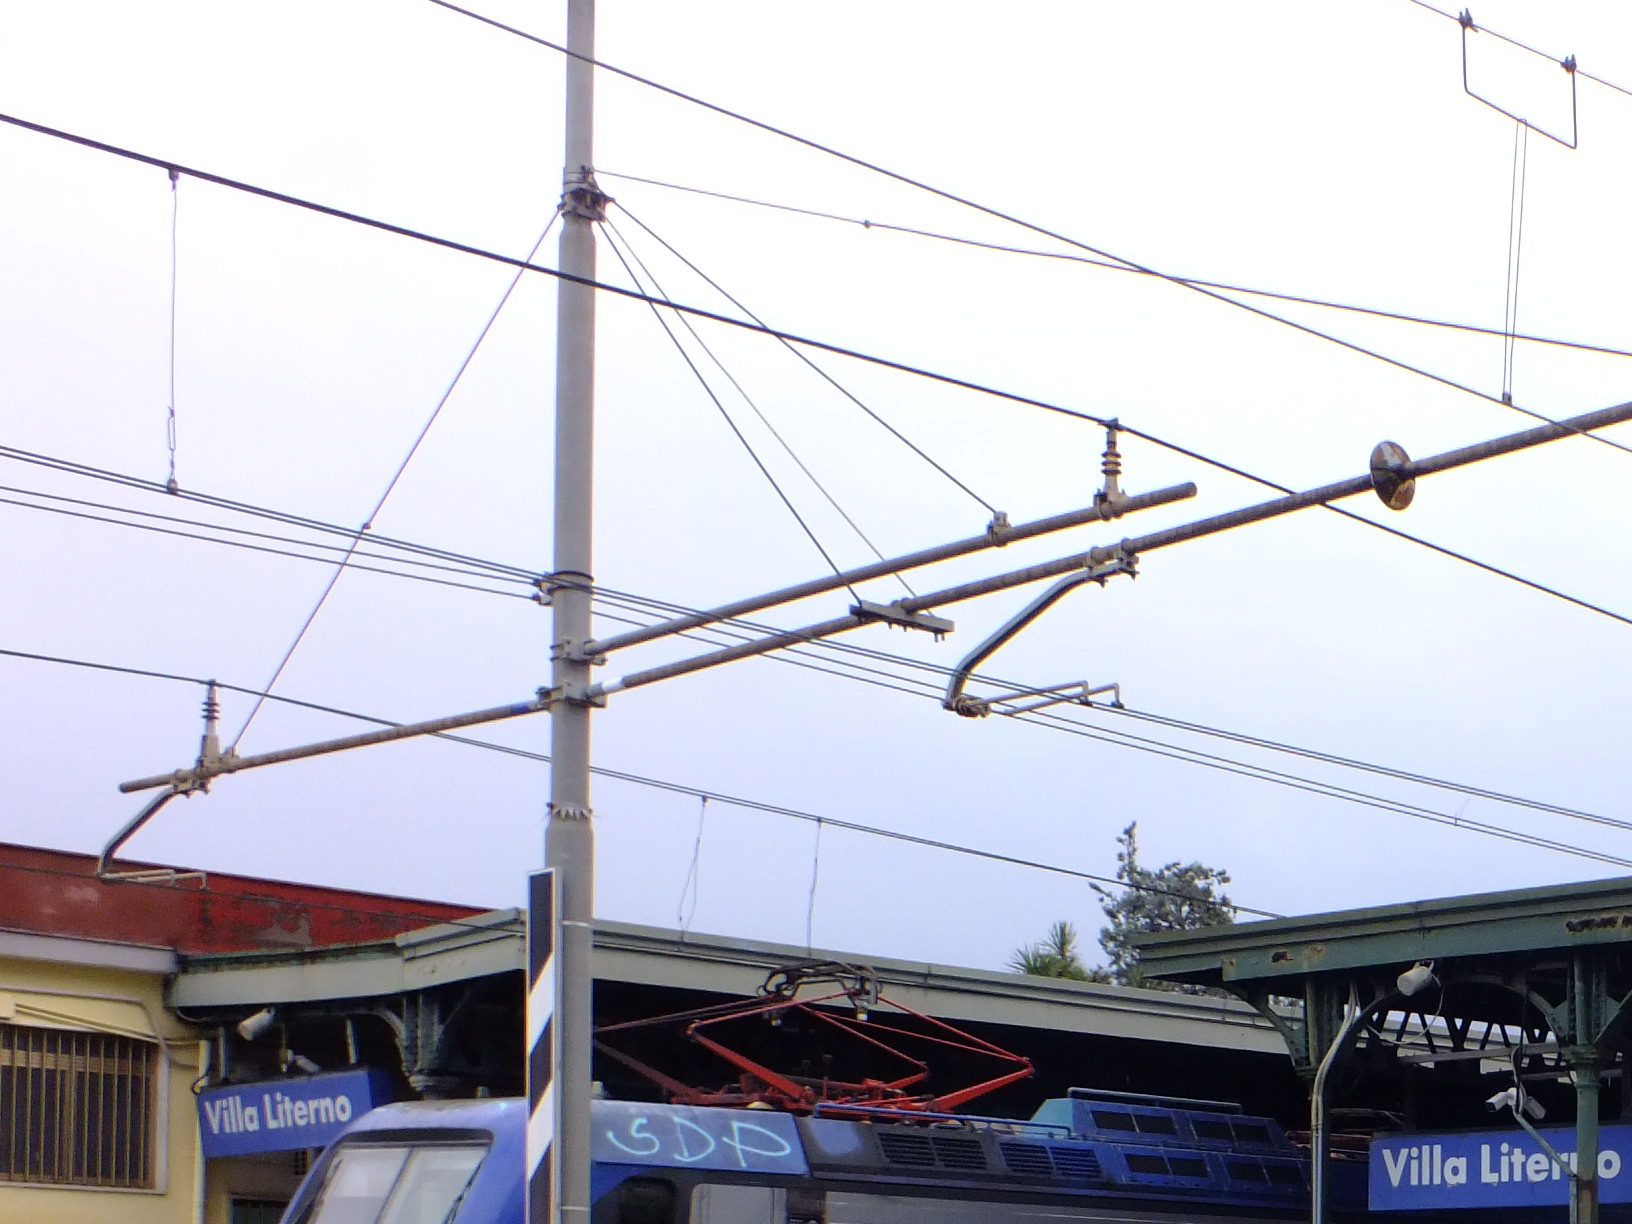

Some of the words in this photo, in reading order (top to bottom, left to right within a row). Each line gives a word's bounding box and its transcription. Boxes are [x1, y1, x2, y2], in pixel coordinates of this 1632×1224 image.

[204, 1096, 260, 1134] Villa
[263, 1092, 352, 1129] Literno
[1382, 1144, 1468, 1188] Villa
[1481, 1142, 1622, 1184] Litero
